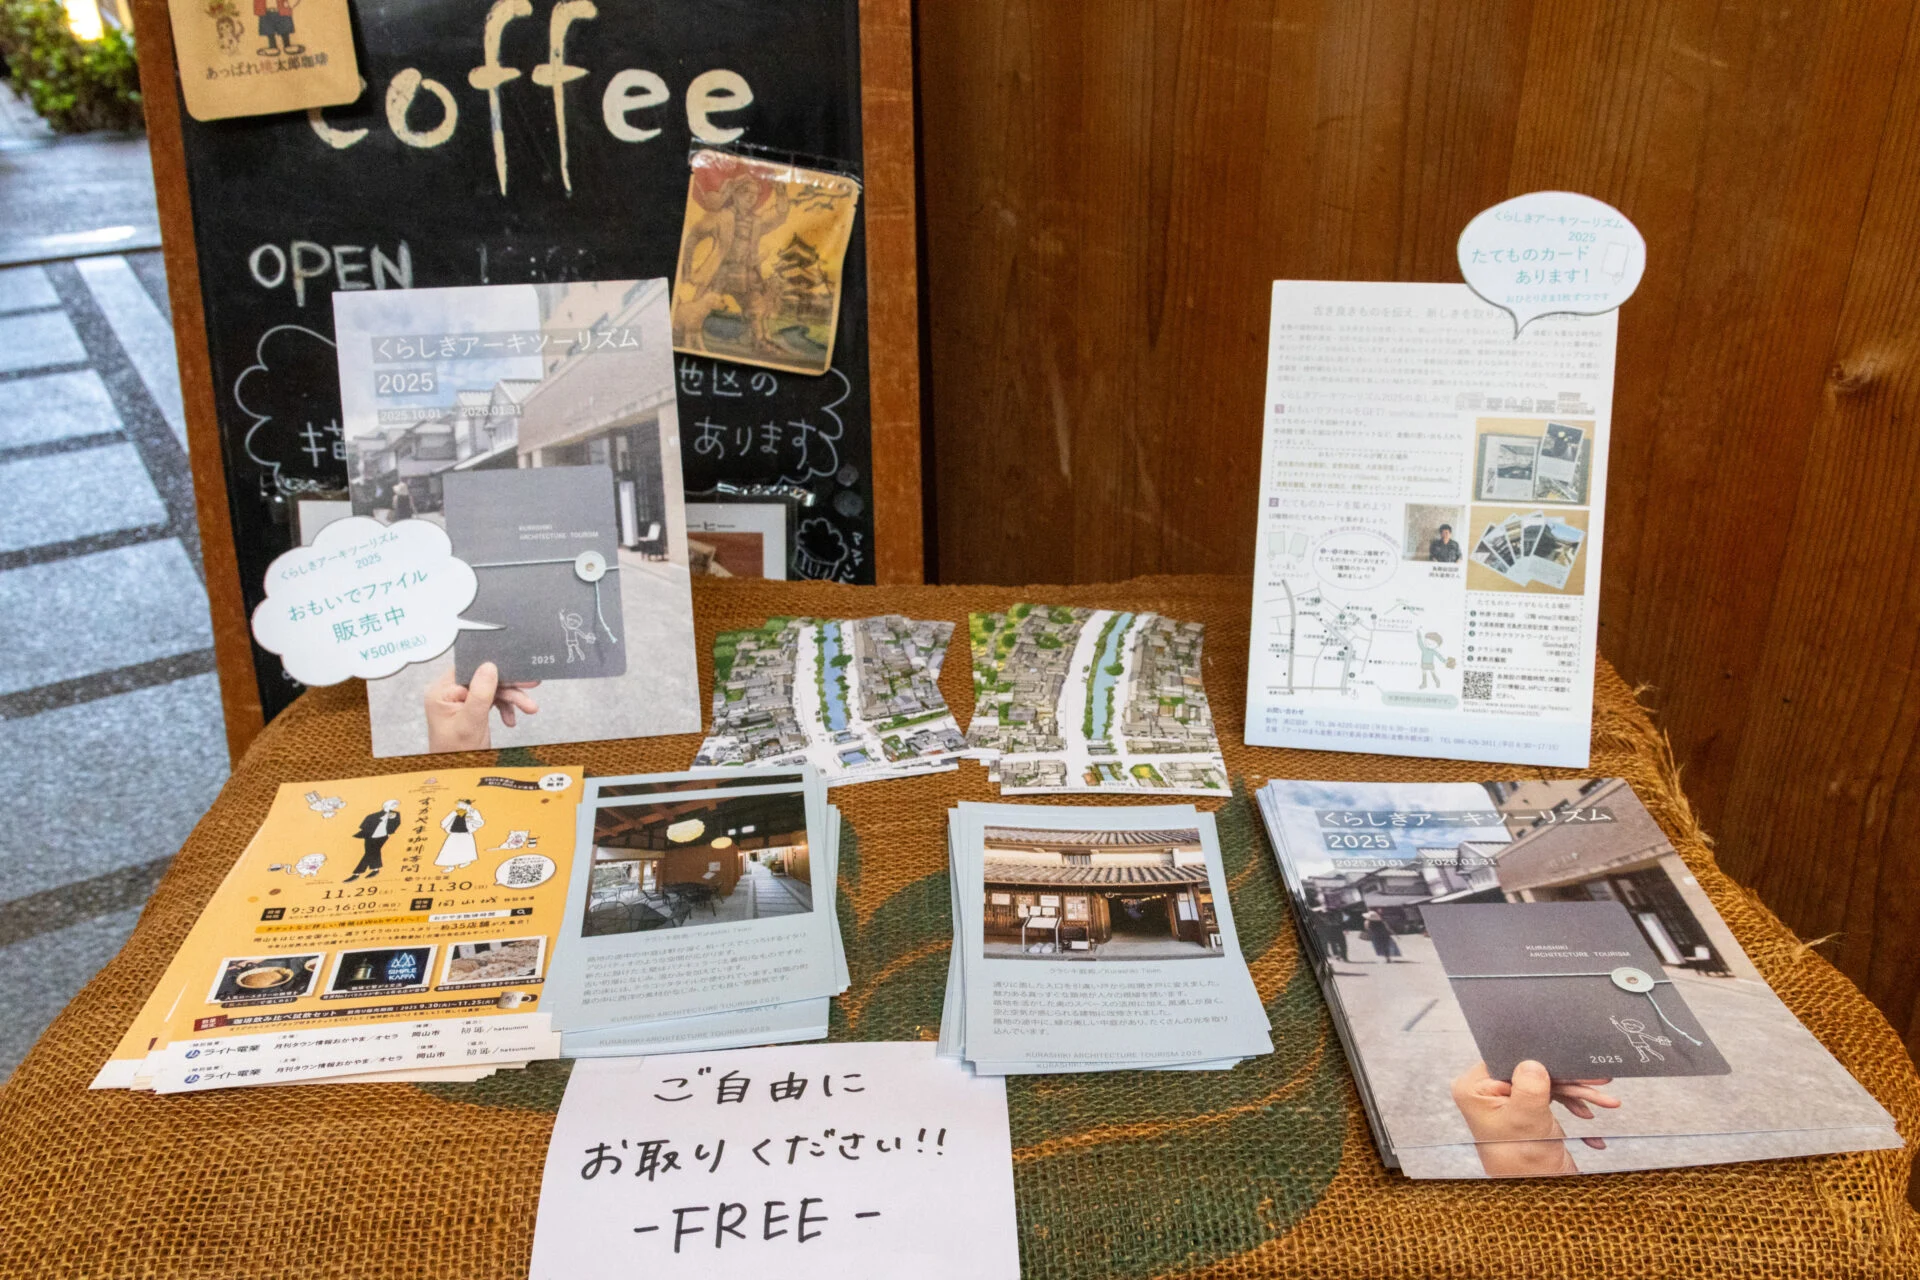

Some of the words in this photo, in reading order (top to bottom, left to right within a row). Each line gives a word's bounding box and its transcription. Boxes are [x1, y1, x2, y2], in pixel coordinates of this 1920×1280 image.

[206, 52, 328, 80] あっぱれ桃太郎珈琲
[1494, 210, 1625, 229] くらしきアーキツーリズム
[1567, 231, 1597, 243] 2025
[1471, 244, 1590, 264] たてものカード
[249, 240, 413, 307] OPEN
[379, 328, 640, 360] くらしきアーキツーリズム
[378, 373, 434, 395] 2025
[381, 407, 442, 422] 2025.10.01
[461, 404, 522, 418] 2026.01.31
[694, 416, 817, 470] あります
[280, 531, 399, 581] くらしきアーキツーリズム
[356, 552, 382, 570] 2025
[288, 569, 429, 623] おもいでファイル
[332, 606, 406, 644] 販売中
[531, 655, 556, 665] 2025
[1323, 807, 1613, 829] くらしきアーキツーリズム
[1327, 833, 1391, 850] 2025
[1335, 858, 1404, 868] 2025.10.01
[1426, 857, 1498, 868] 2026.01.31
[322, 886, 378, 899] 11.29
[415, 881, 473, 893] 11.30
[233, 1010, 338, 1025] 珈琲飲み比べ試飲セット
[411, 1030, 440, 1038] 岡山市
[204, 1044, 261, 1056] ライト電業
[416, 1051, 445, 1060] 岡山市
[1589, 1055, 1623, 1064] 2025
[204, 1068, 262, 1081] ライト電業
[654, 1066, 866, 1105] ご自由に
